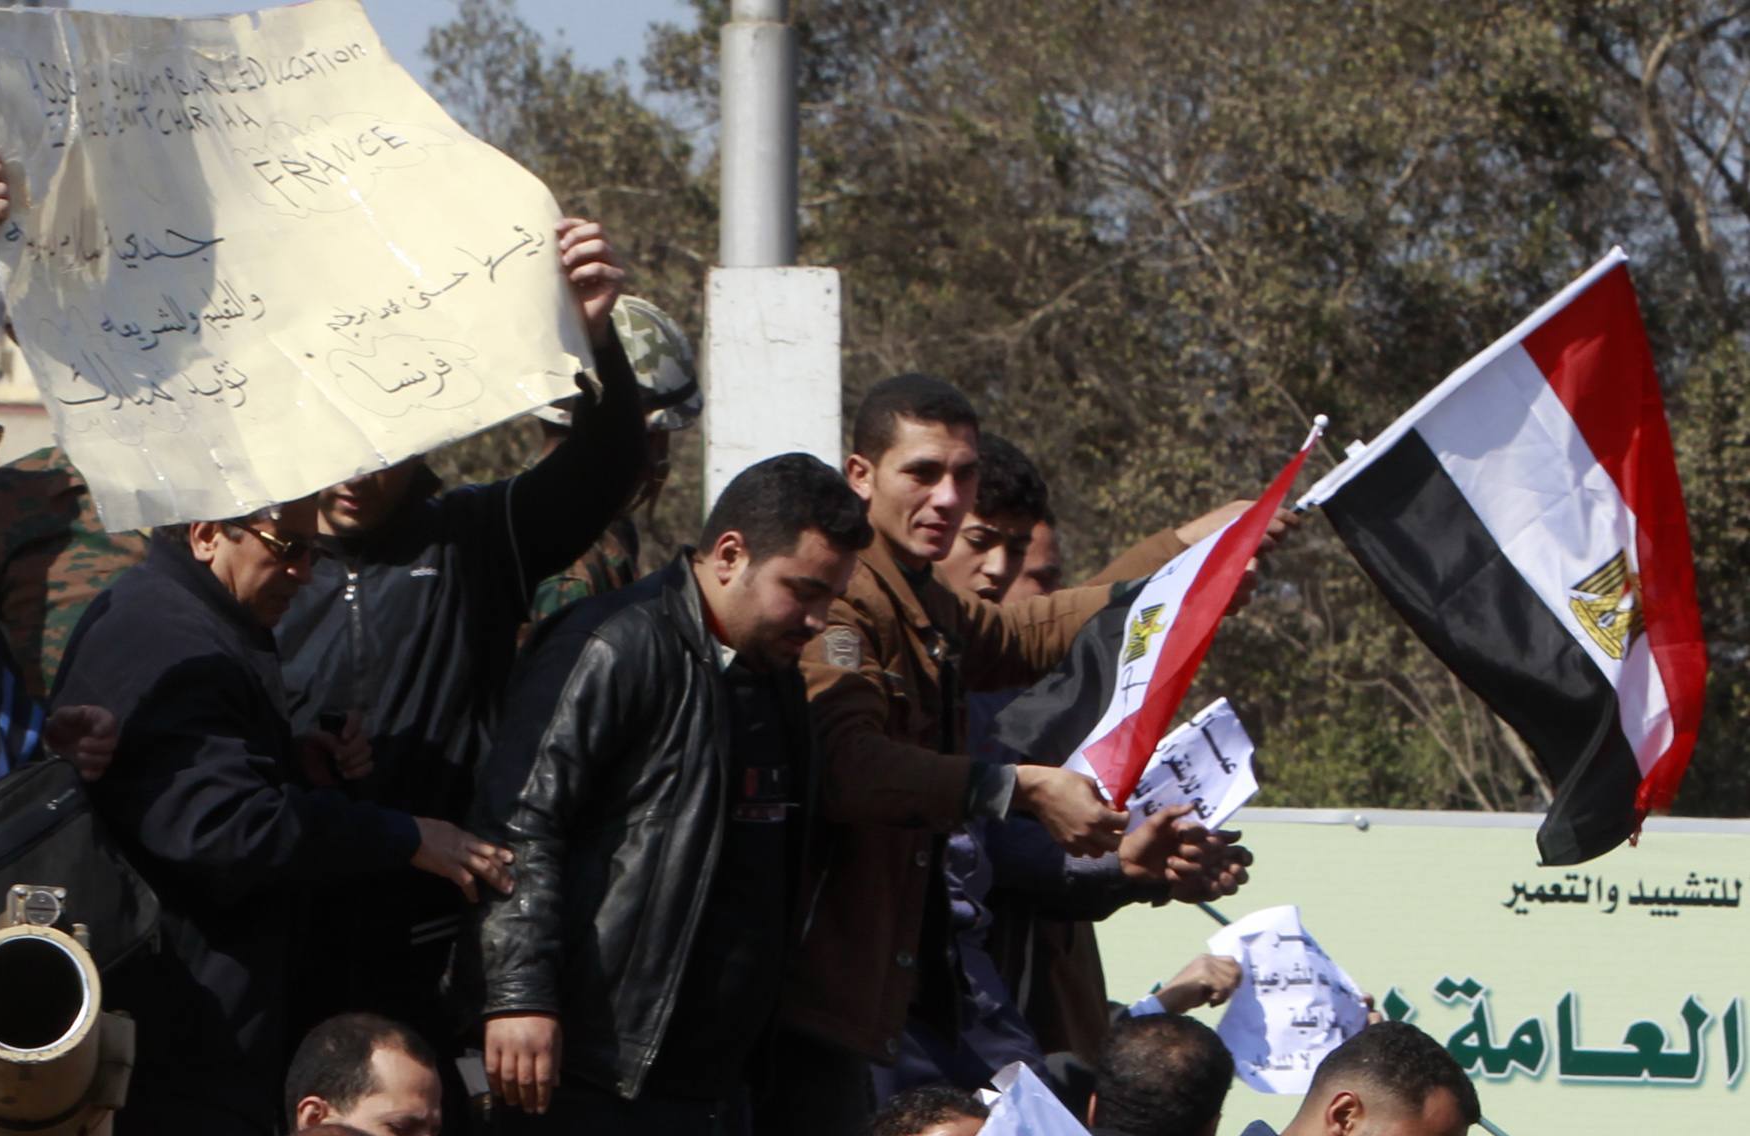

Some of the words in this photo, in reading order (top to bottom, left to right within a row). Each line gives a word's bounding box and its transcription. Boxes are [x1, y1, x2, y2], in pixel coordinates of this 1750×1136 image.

[253, 126, 408, 207] FRANCE
[346, 350, 453, 398] فرنسا
[1502, 873, 1619, 915] والتعمير
[1628, 872, 1742, 917] للتشييد
[1433, 976, 1742, 1086] العامة
